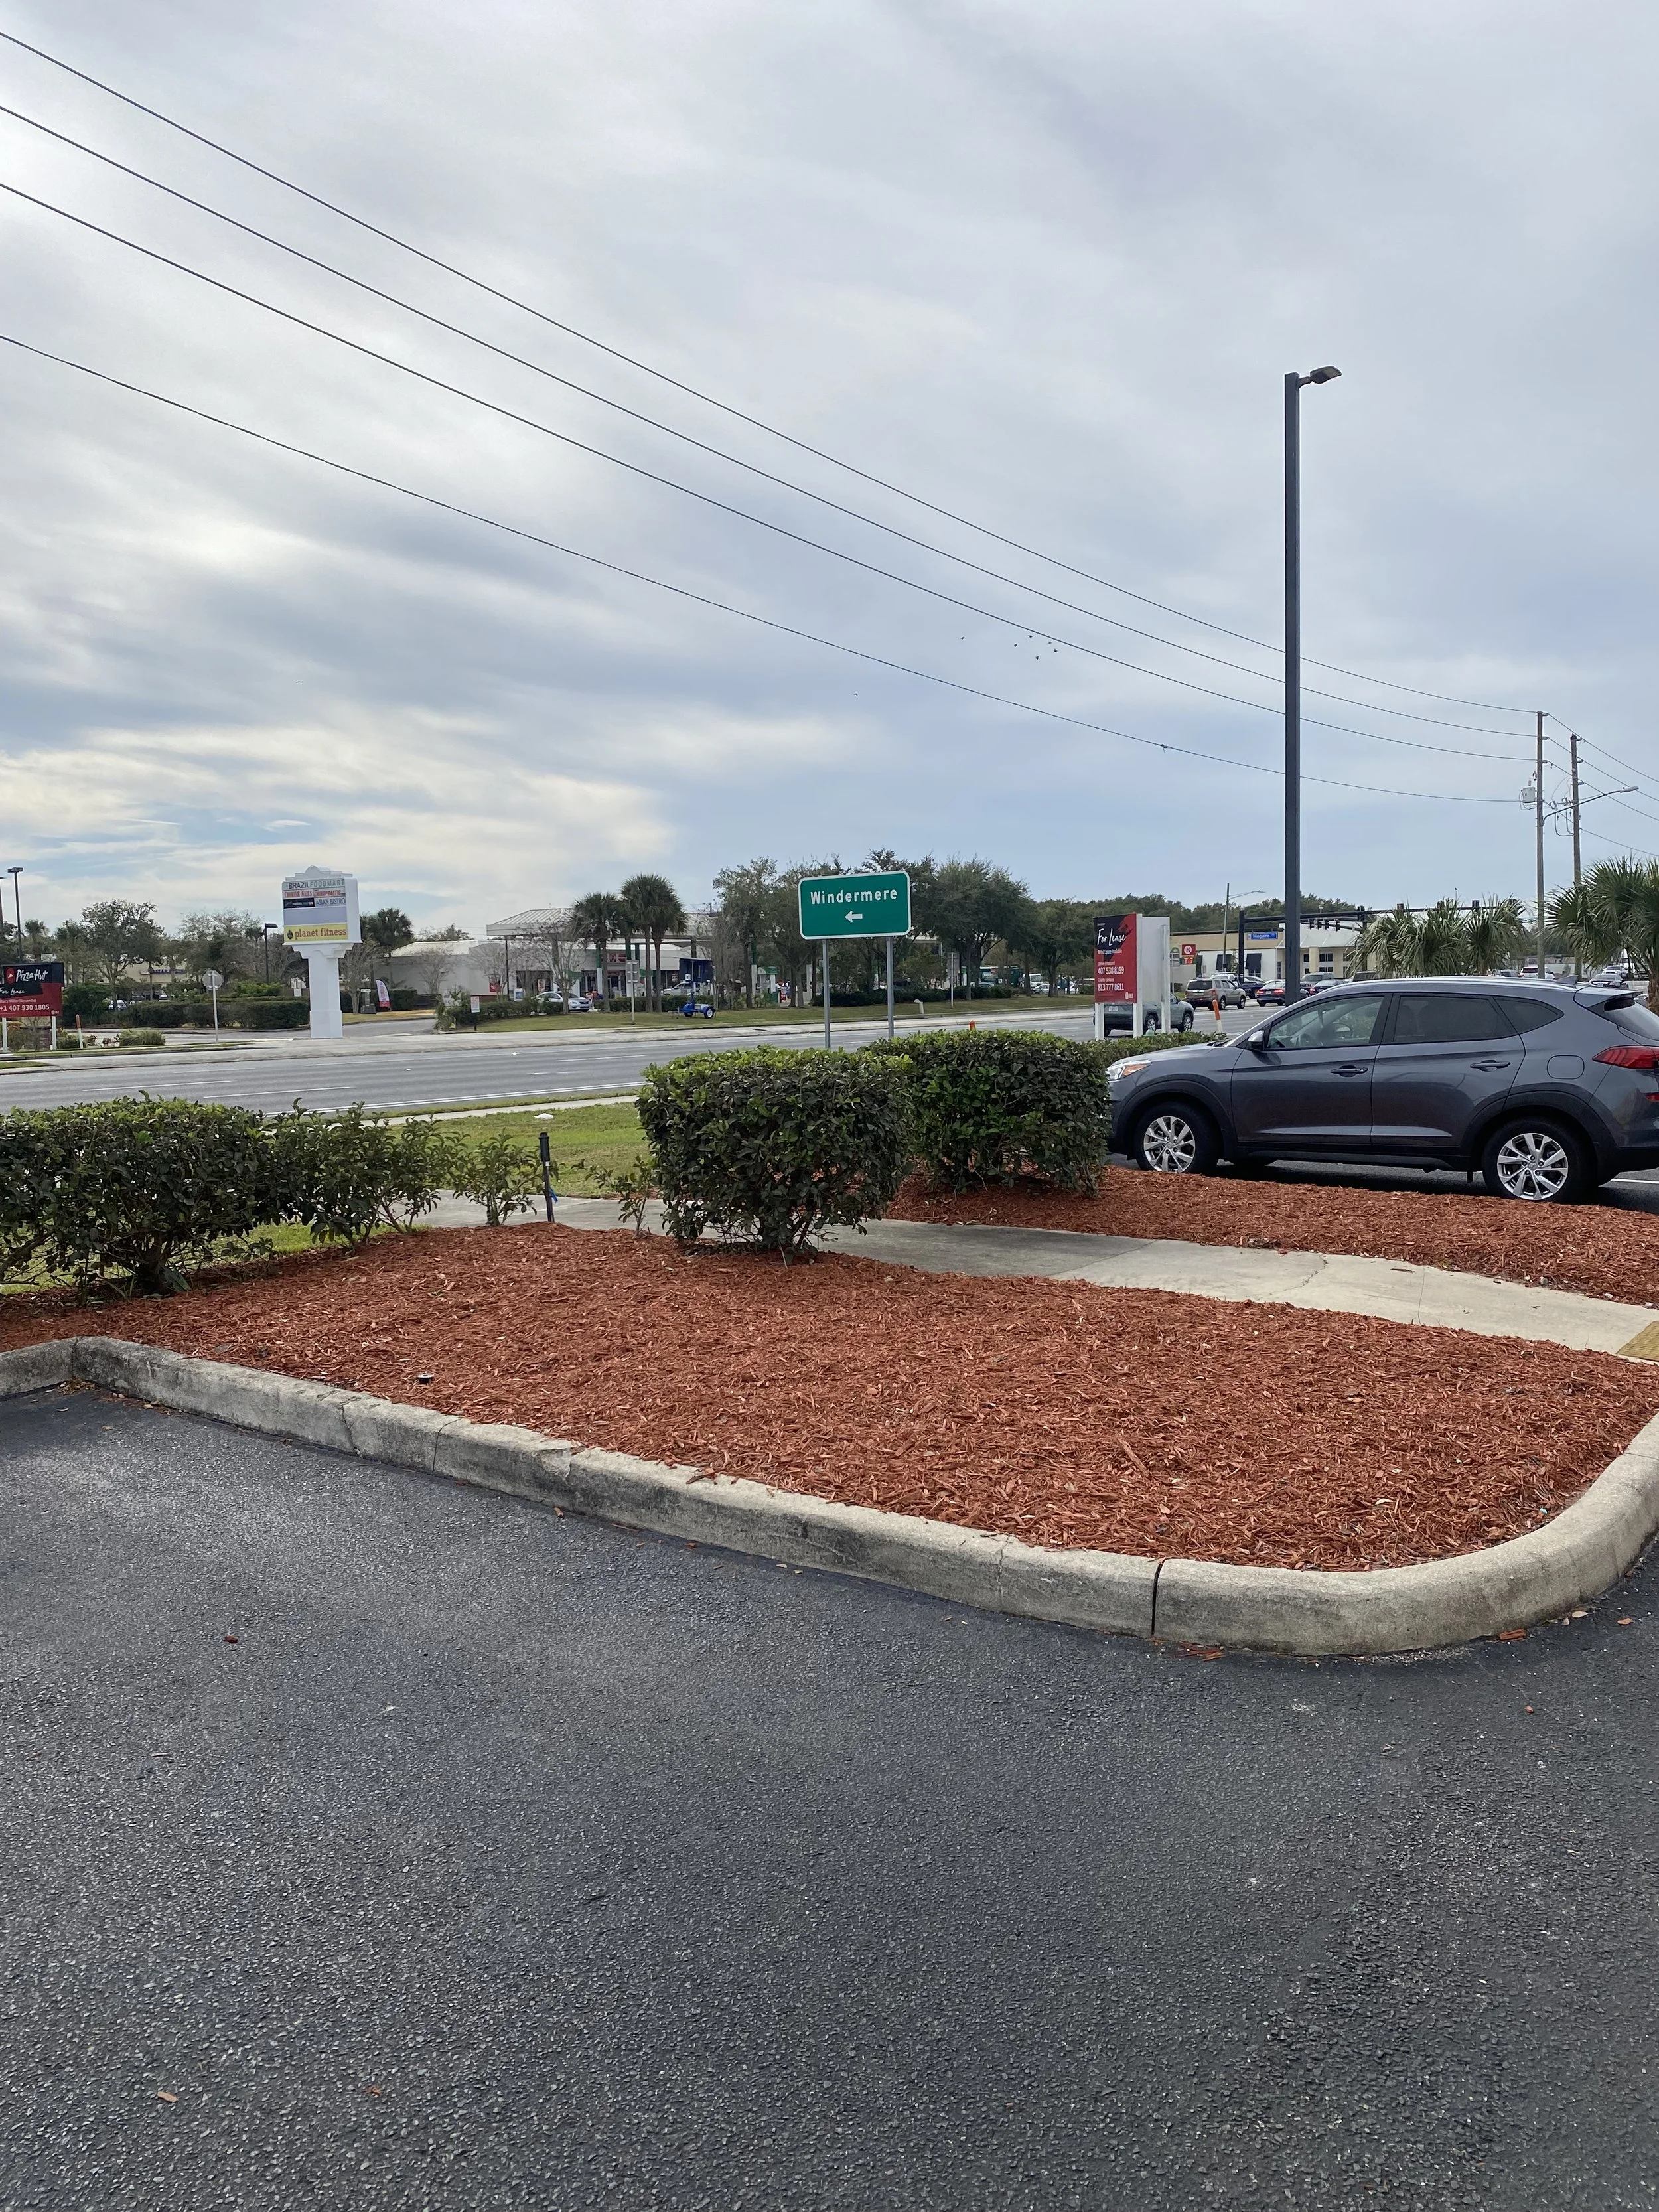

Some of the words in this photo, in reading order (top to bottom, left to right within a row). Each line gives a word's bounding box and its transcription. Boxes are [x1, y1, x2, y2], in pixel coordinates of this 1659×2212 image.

[810, 889, 897, 905] Windermere
[295, 928, 318, 940] planet
[321, 928, 346, 936] fitness
[1097, 928, 1107, 945] For
[1108, 928, 1126, 946] Lease
[16, 969, 34, 982] Pizza
[34, 969, 48, 981] Hut
